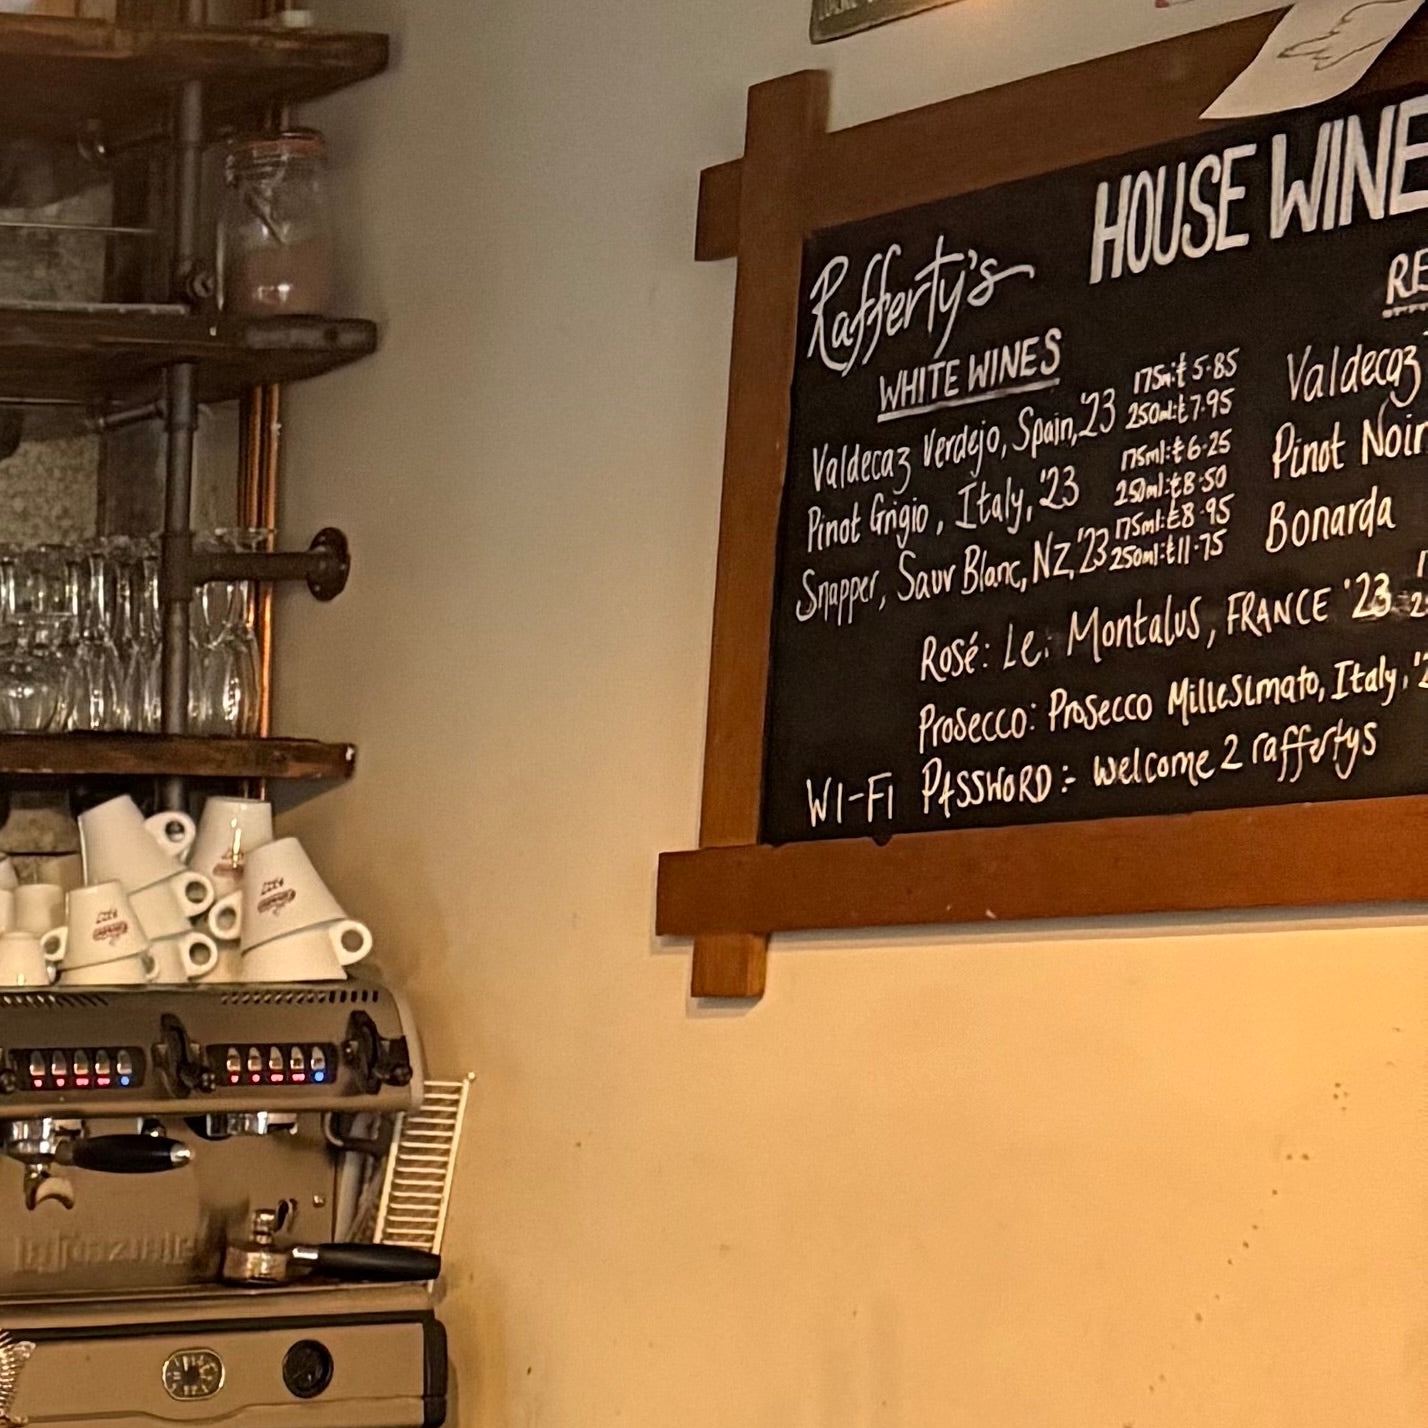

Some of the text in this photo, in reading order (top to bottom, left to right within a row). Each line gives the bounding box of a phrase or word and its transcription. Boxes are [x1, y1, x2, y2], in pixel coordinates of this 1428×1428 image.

[1089, 143, 1259, 285] HOUSE
[807, 235, 1036, 378] Rafferty's
[879, 327, 1062, 412] WHITE WINES
[1272, 397, 1428, 480] Pinot Noir
[807, 502, 862, 553] Pinot
[1265, 485, 1397, 553] Bonarda
[1227, 587, 1332, 637] FRANCE
[1049, 688, 1153, 732] Prosecco
[806, 772, 893, 828] WI-FI
[1093, 747, 1216, 788] welcome
[1220, 733, 1243, 770] 2
